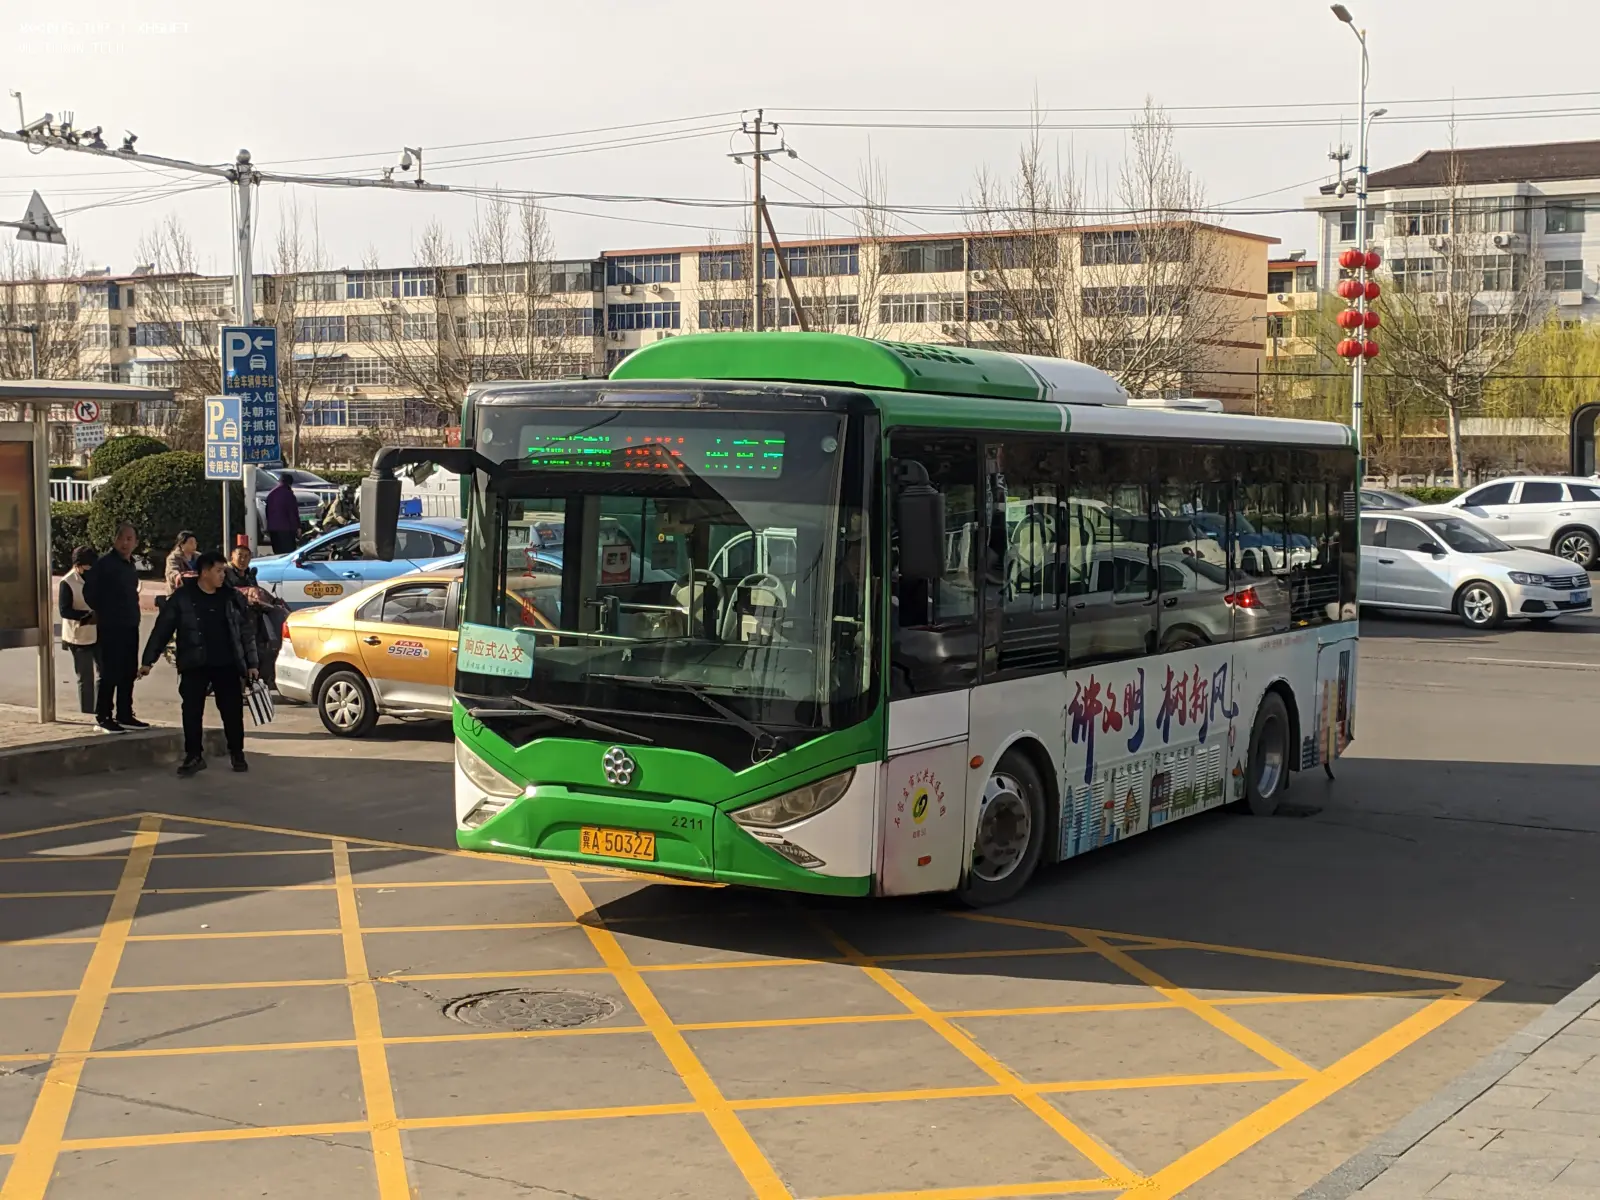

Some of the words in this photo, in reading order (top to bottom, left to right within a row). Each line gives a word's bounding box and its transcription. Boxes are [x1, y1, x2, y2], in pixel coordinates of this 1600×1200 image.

[241, 406, 276, 418] 头朝东
[242, 420, 276, 432] 子抓拍
[242, 434, 276, 446] 时停放
[208, 446, 239, 459] 出租车
[208, 460, 239, 474] 专用车位
[388, 646, 422, 657] 95128
[464, 638, 525, 663] 响应式公交
[671, 815, 703, 831] 2211
